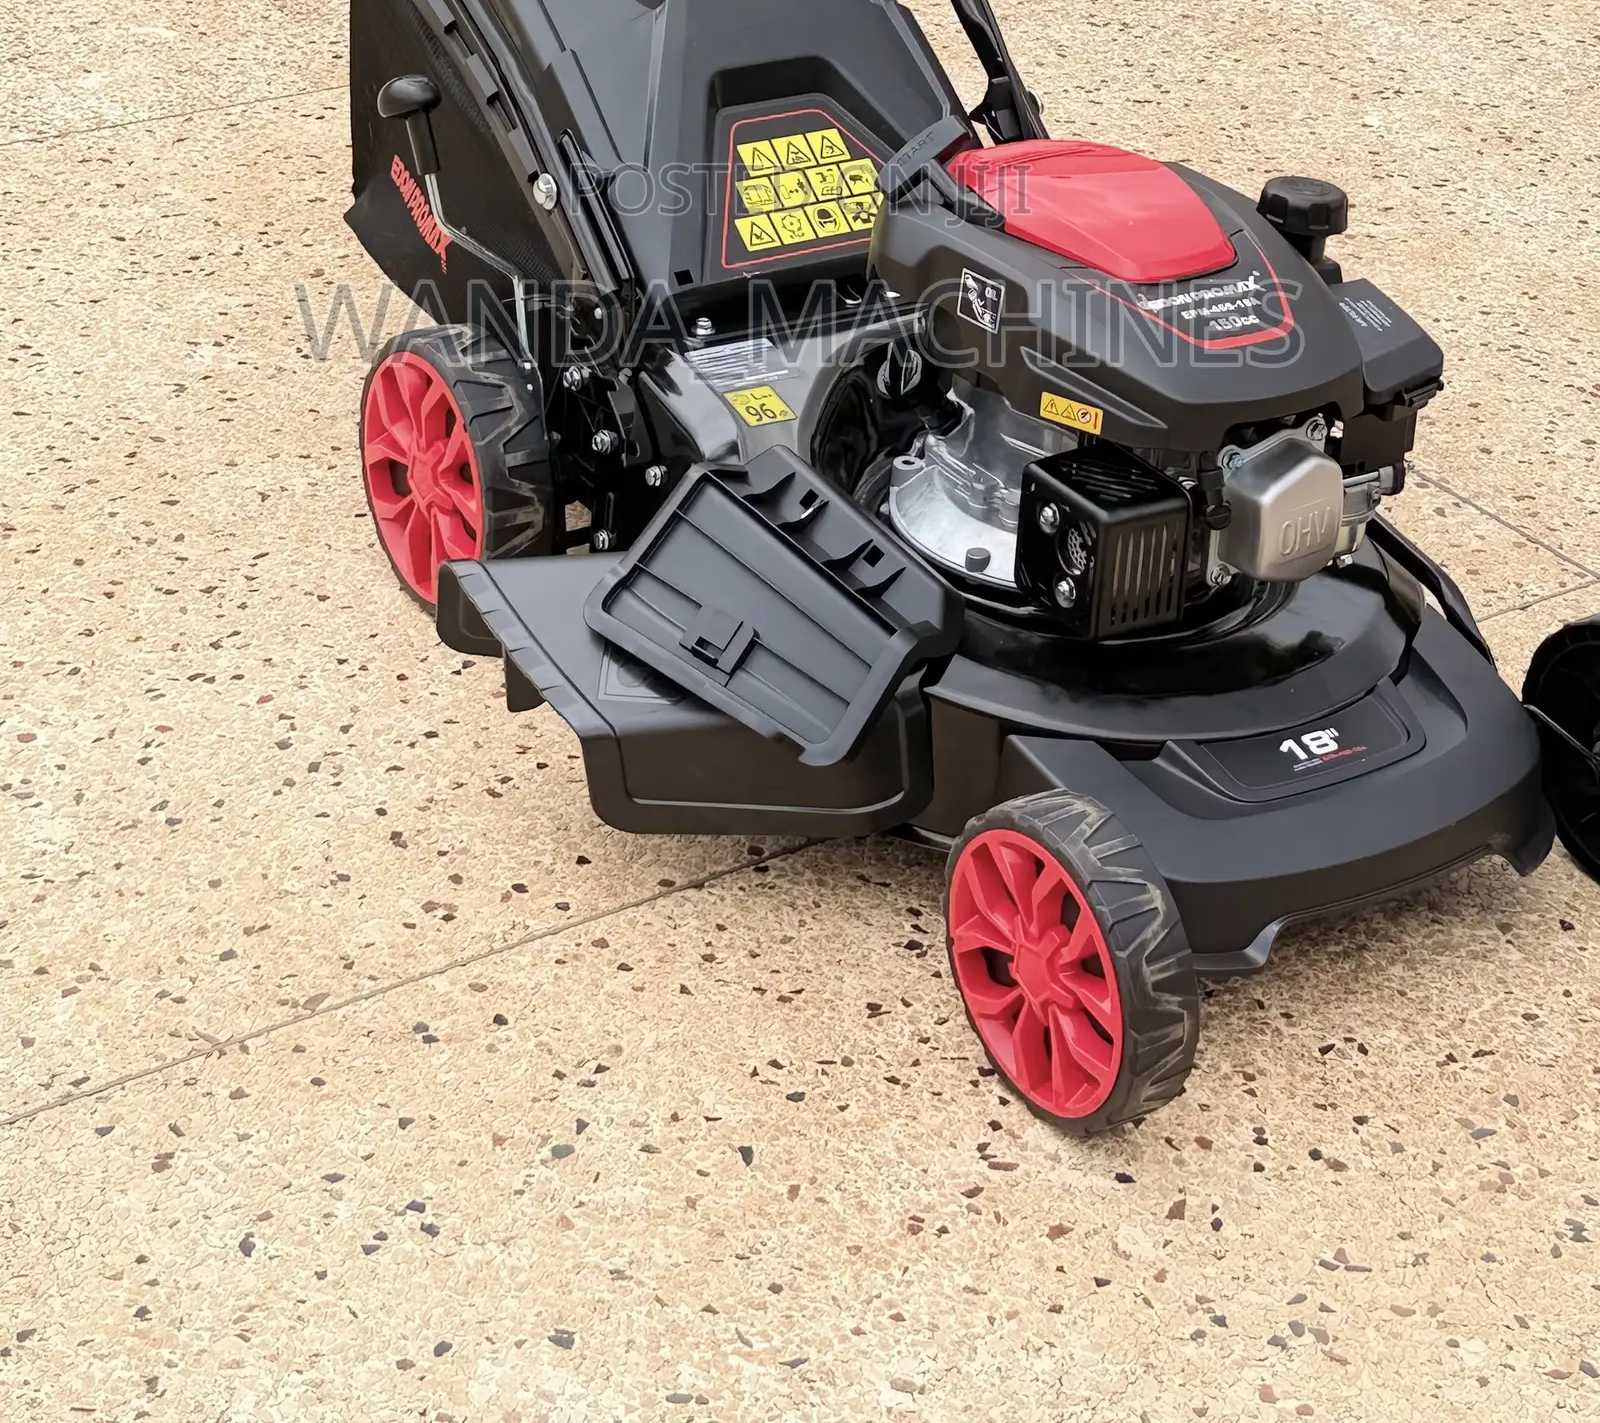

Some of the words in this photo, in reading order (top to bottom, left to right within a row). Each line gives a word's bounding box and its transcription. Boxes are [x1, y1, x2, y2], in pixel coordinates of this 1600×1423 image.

[896, 131, 935, 166] START
[745, 403, 777, 422] 96
[1280, 507, 1331, 557] OHV
[1280, 728, 1339, 760] 18"
